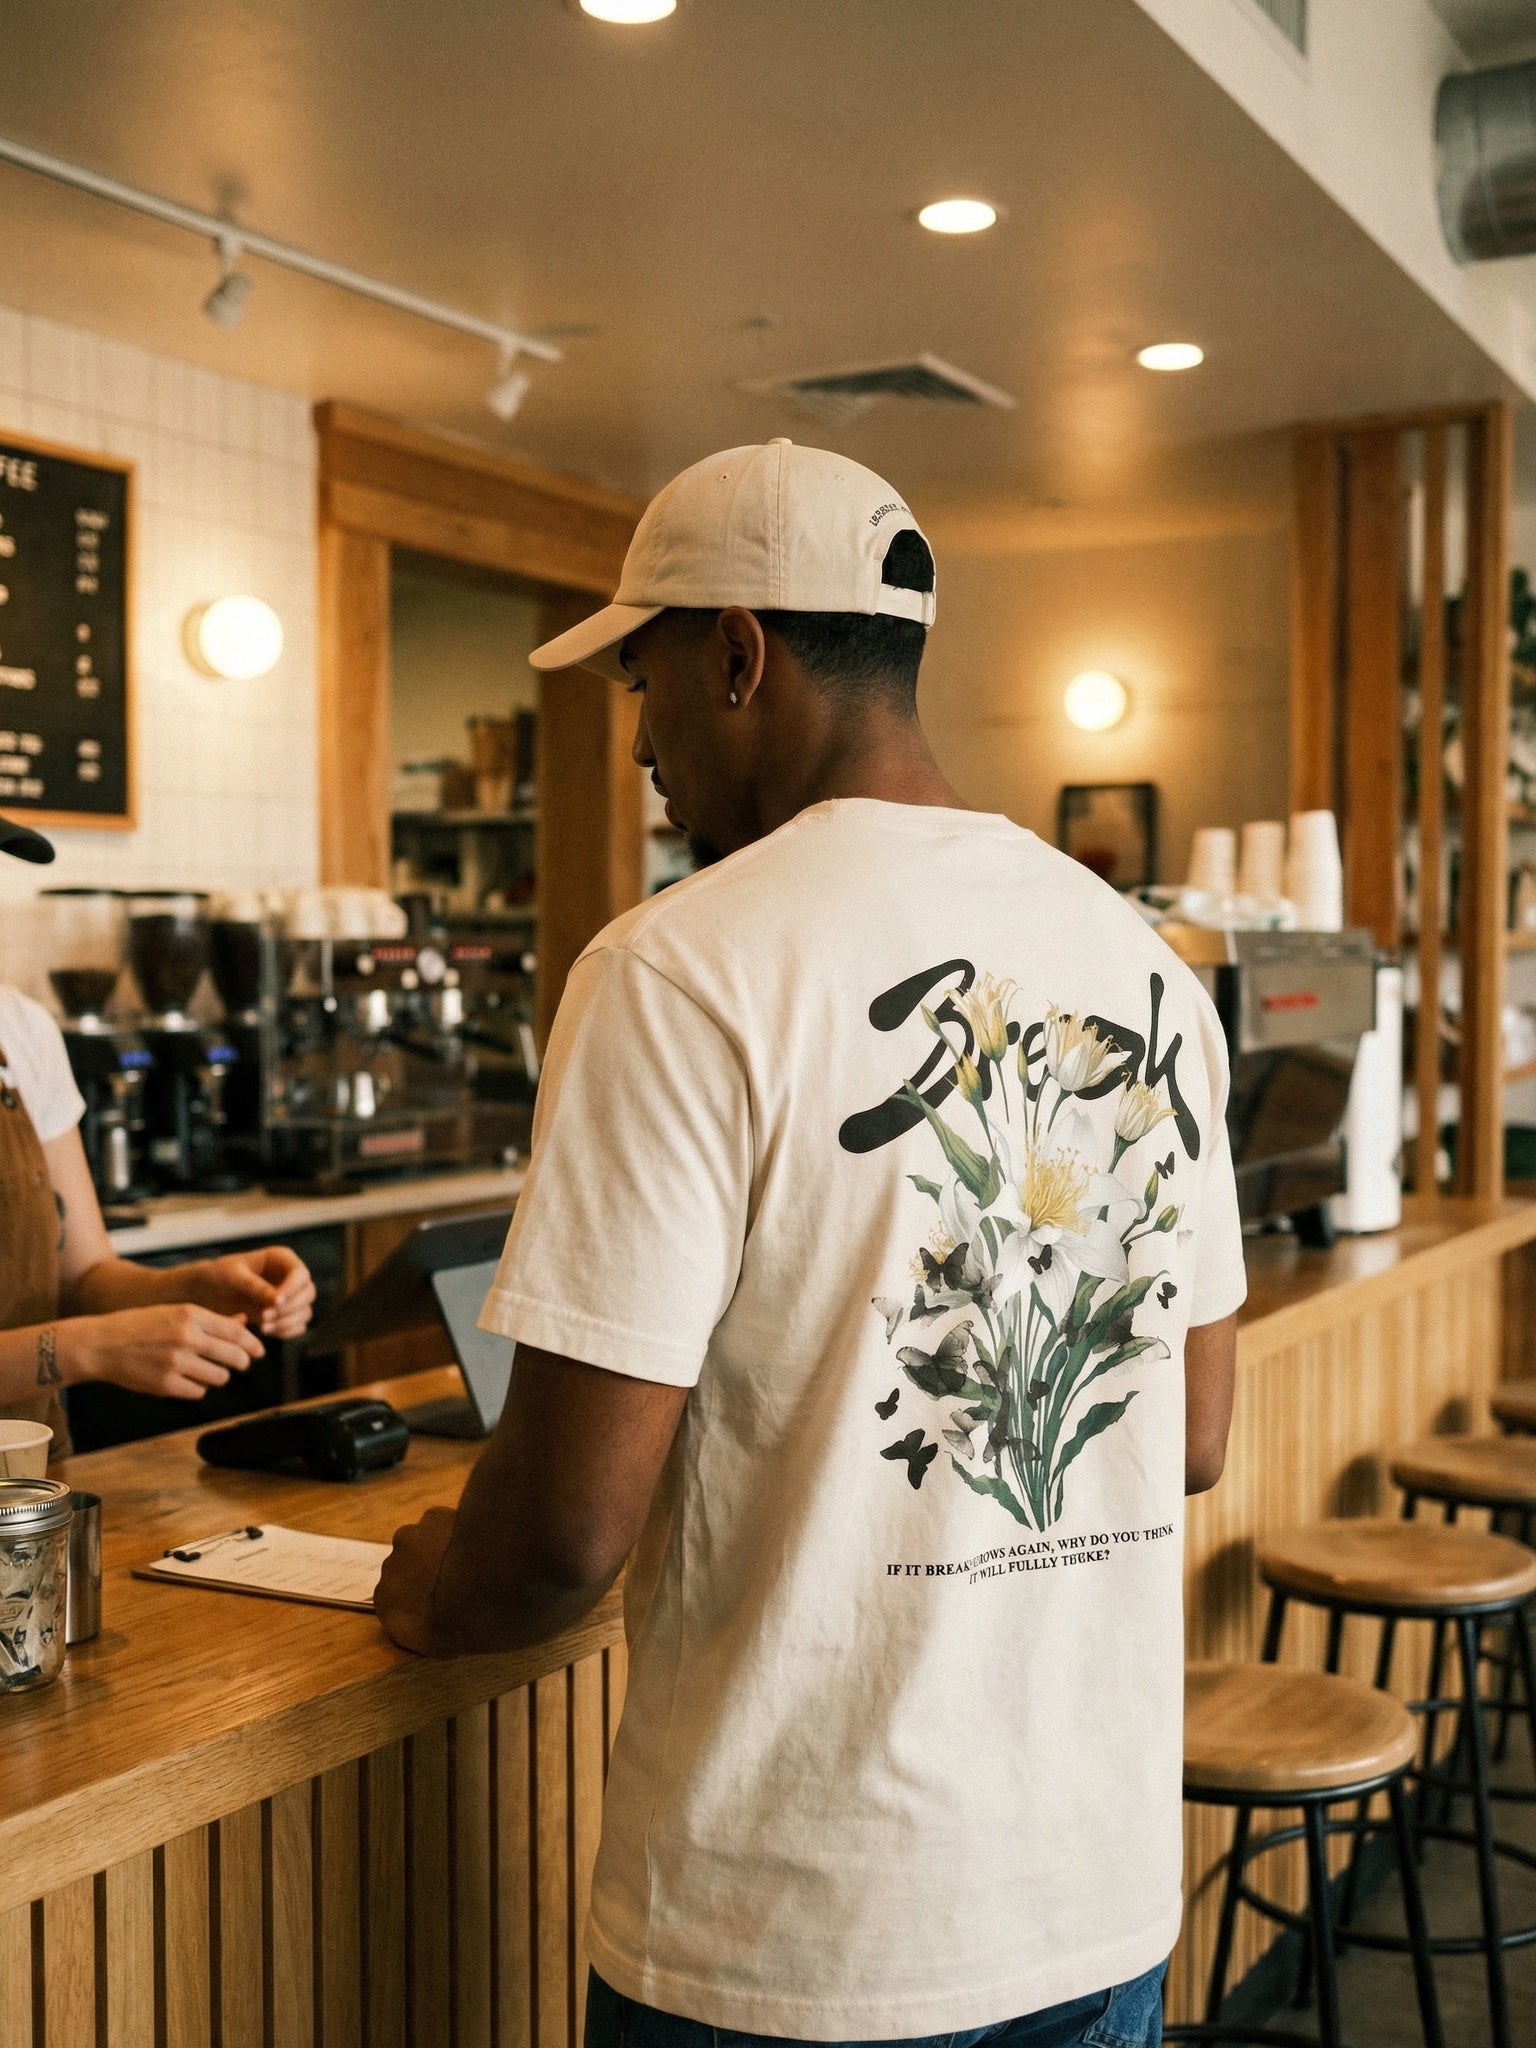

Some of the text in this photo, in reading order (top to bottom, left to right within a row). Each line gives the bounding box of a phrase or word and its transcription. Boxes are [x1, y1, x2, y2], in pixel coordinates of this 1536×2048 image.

[886, 1564, 902, 1576] IF
[905, 1564, 921, 1576] IT
[1008, 1541, 1055, 1559] AGAIN,
[1090, 1533, 1110, 1547] DO
[1112, 1530, 1140, 1544] YOU
[980, 1564, 1006, 1580] WILL
